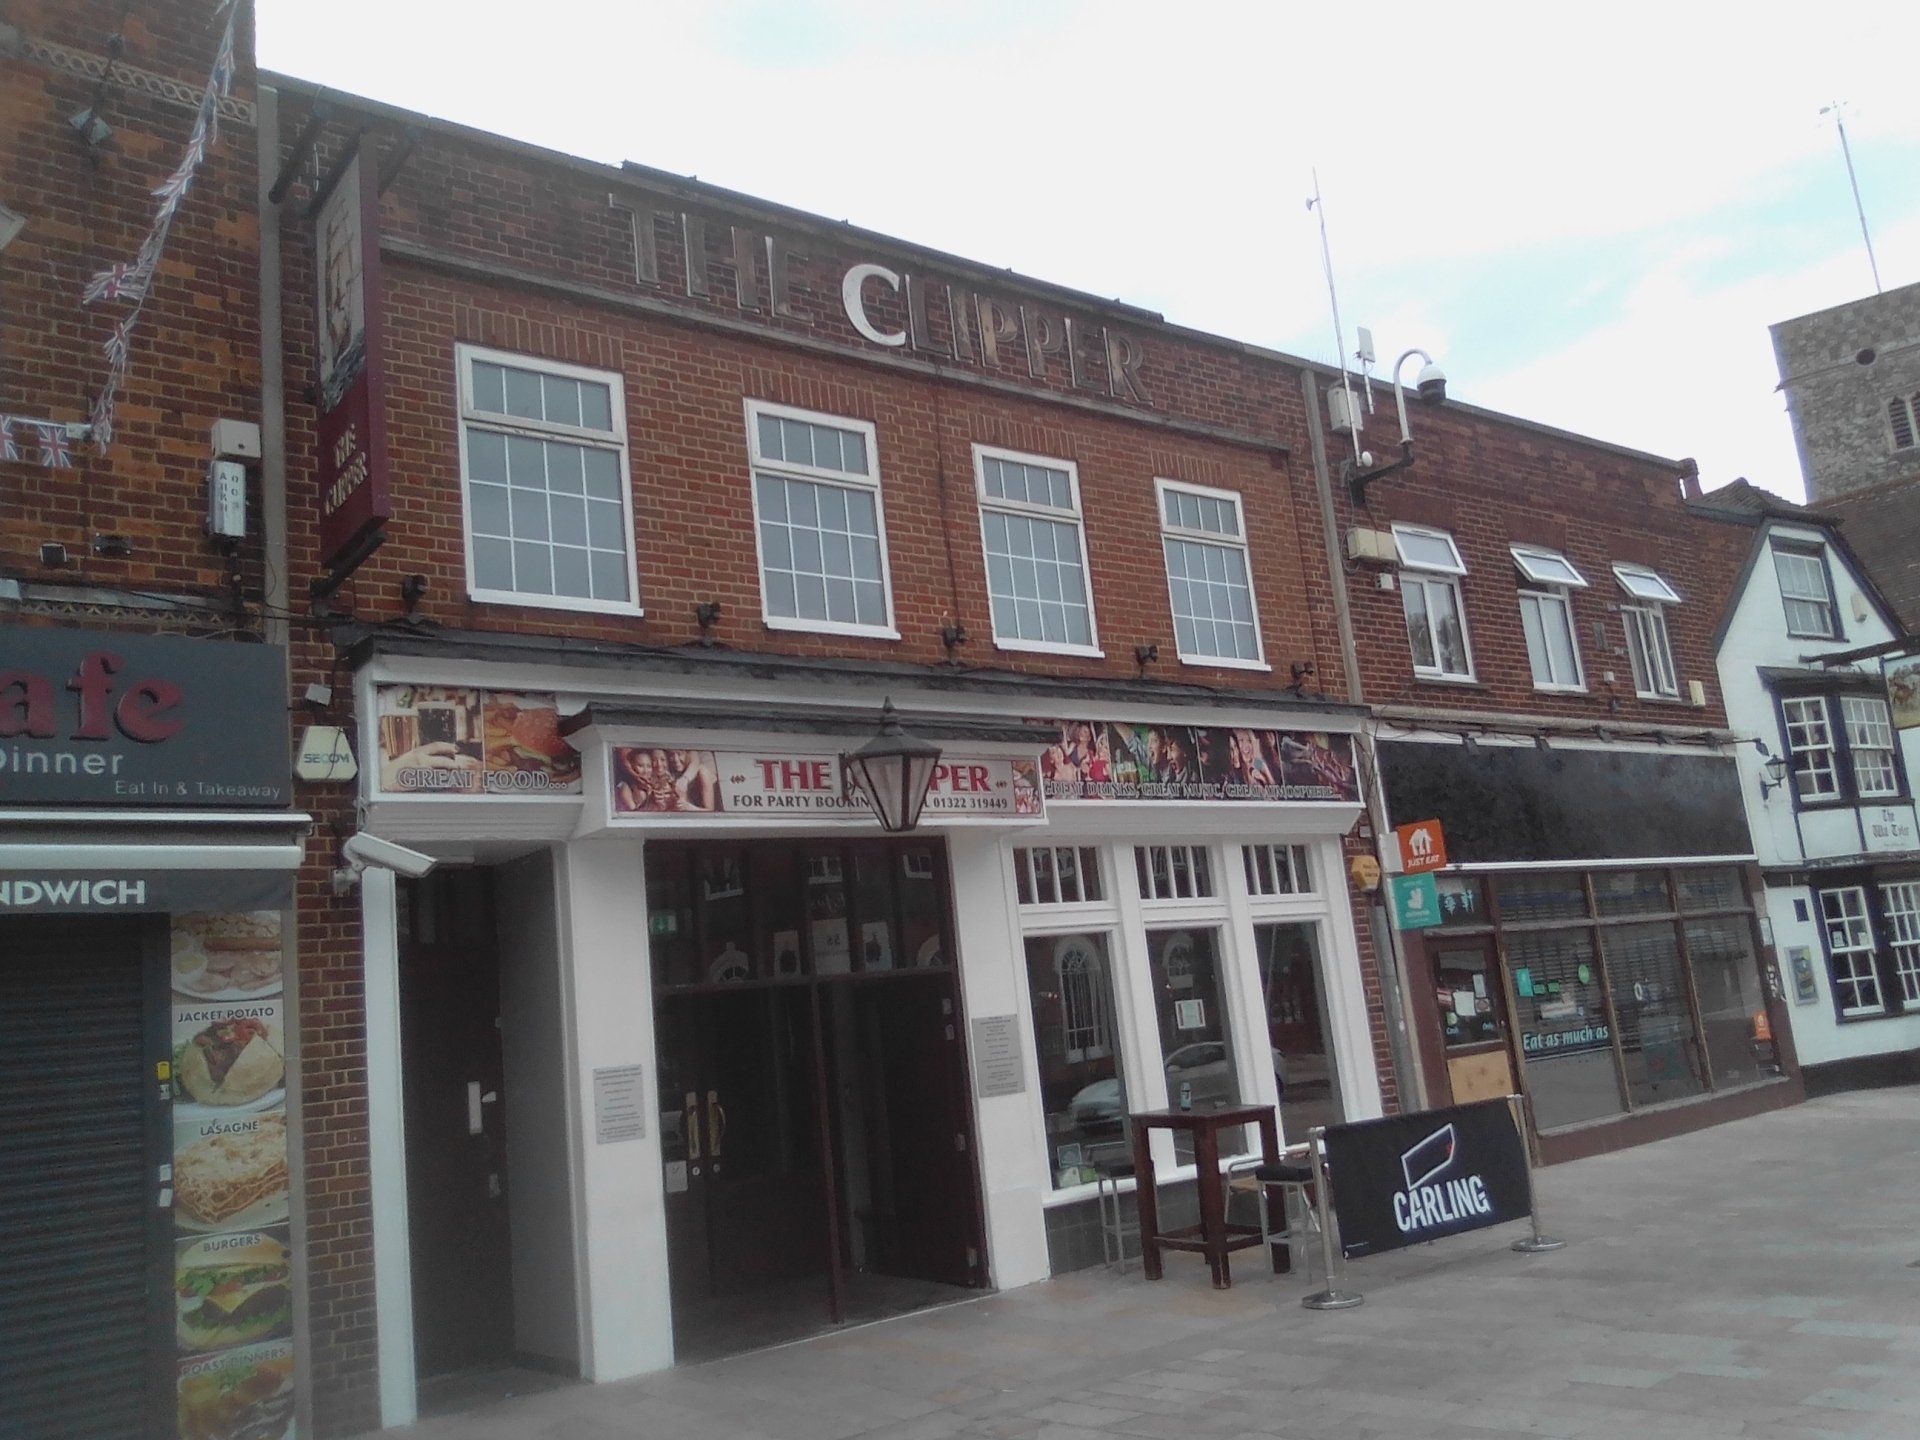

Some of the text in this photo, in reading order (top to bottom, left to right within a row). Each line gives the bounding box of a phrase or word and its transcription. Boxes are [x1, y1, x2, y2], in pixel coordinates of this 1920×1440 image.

[608, 193, 1155, 406] THE CLIPPER
[304, 753, 350, 764] SECOM
[398, 769, 475, 789] GREAT
[754, 758, 833, 792] THE
[115, 780, 281, 799] Eat In & Takeaway
[1044, 781, 1084, 796] GREAT
[1142, 782, 1181, 797] GREAT
[733, 795, 871, 809] FOR PARTY BOOKIN
[933, 797, 967, 809] 01322
[970, 797, 1008, 809] 319449
[1407, 854, 1440, 868] JUST EAT
[178, 1007, 274, 1022] JACKET POTATO
[1523, 1024, 1609, 1050] Eat as much as
[200, 1120, 260, 1136] LASAGNE
[1393, 1174, 1491, 1232] CARLING
[203, 1234, 262, 1252] BURGERS
